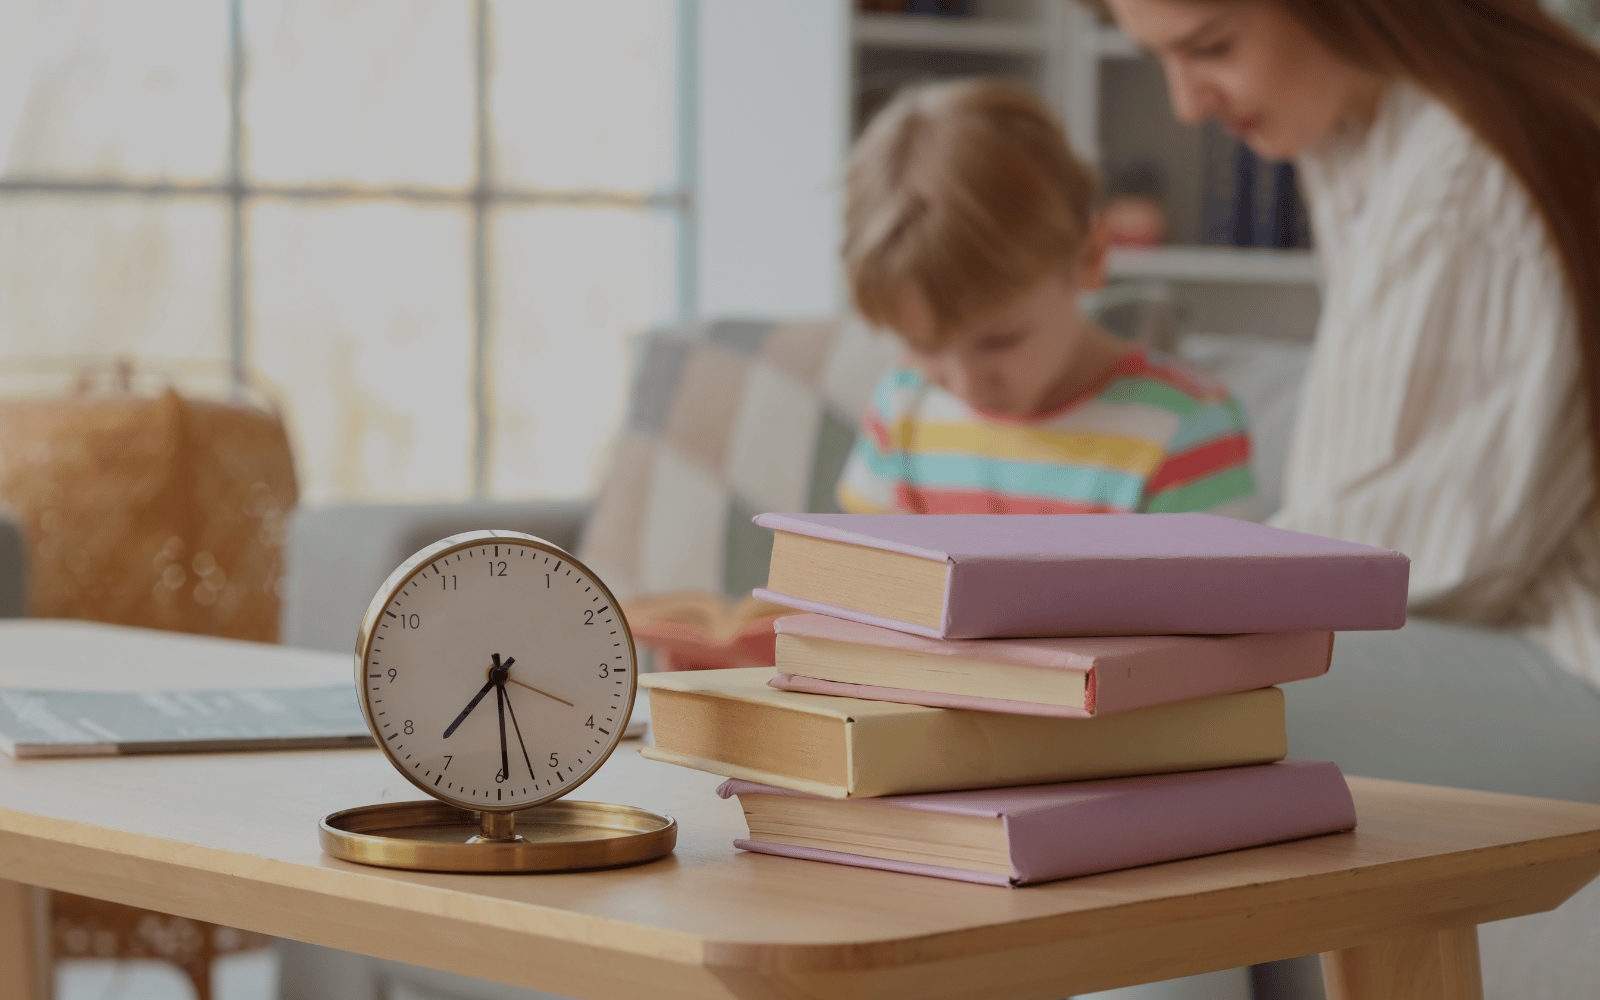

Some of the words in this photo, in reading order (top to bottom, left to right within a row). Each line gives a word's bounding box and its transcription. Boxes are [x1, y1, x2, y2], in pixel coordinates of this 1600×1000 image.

[488, 561, 508, 577] 12
[441, 575, 457, 590] 11
[545, 573, 550, 589] 1
[400, 613, 420, 629] 10
[584, 610, 594, 625] 2
[387, 668, 397, 683] 9
[598, 663, 609, 679] 3
[403, 719, 415, 735] 8
[584, 714, 595, 730] 4
[443, 755, 453, 770] 7
[548, 752, 559, 768] 5
[495, 768, 506, 784] 6
